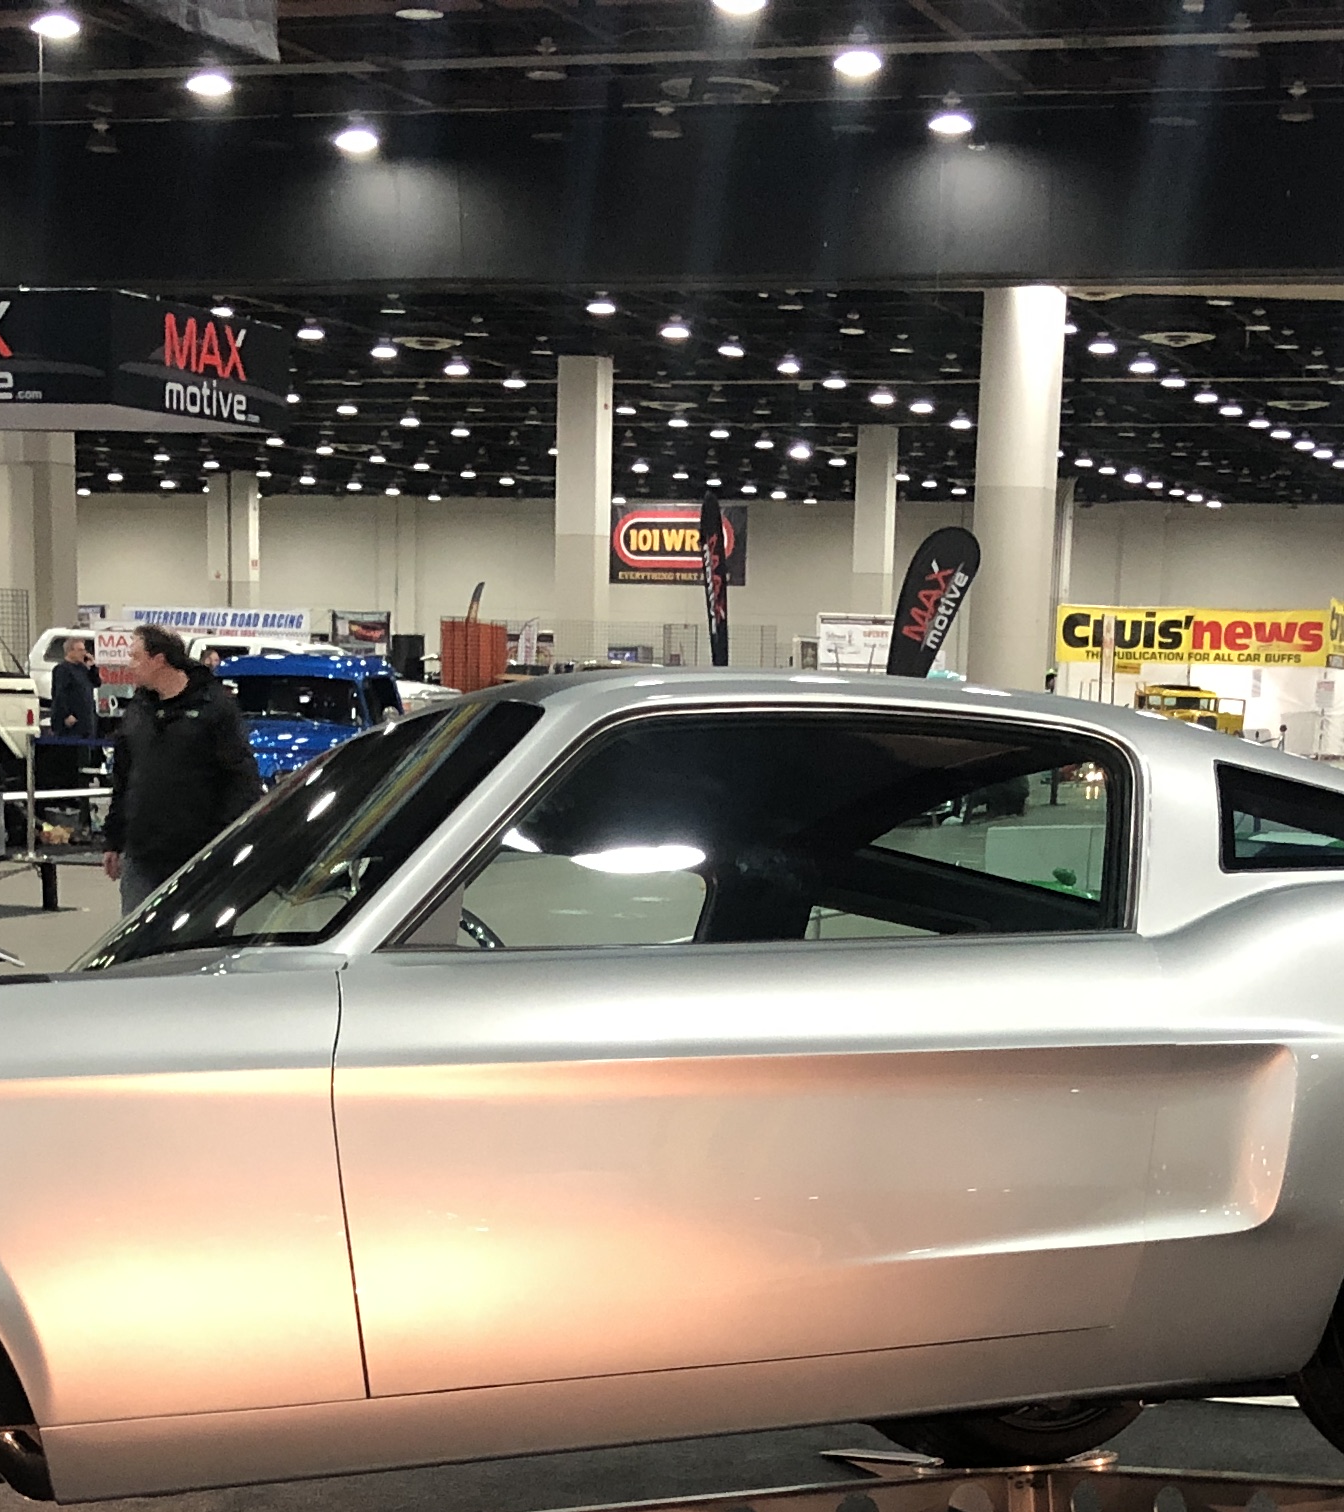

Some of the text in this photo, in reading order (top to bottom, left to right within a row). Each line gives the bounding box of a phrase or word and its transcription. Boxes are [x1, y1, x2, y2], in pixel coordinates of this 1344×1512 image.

[164, 312, 247, 382] MAX
[629, 528, 660, 551] 101
[902, 559, 955, 643] MAX
[926, 571, 970, 650] motive
[134, 610, 304, 629] WATERFORD HILLS ROAD RACING
[98, 634, 133, 648] MA
[1188, 652, 1210, 663] FOR
[1213, 653, 1233, 662] ALL
[1237, 653, 1261, 663] CAR
[1264, 654, 1301, 663] BUFFS
